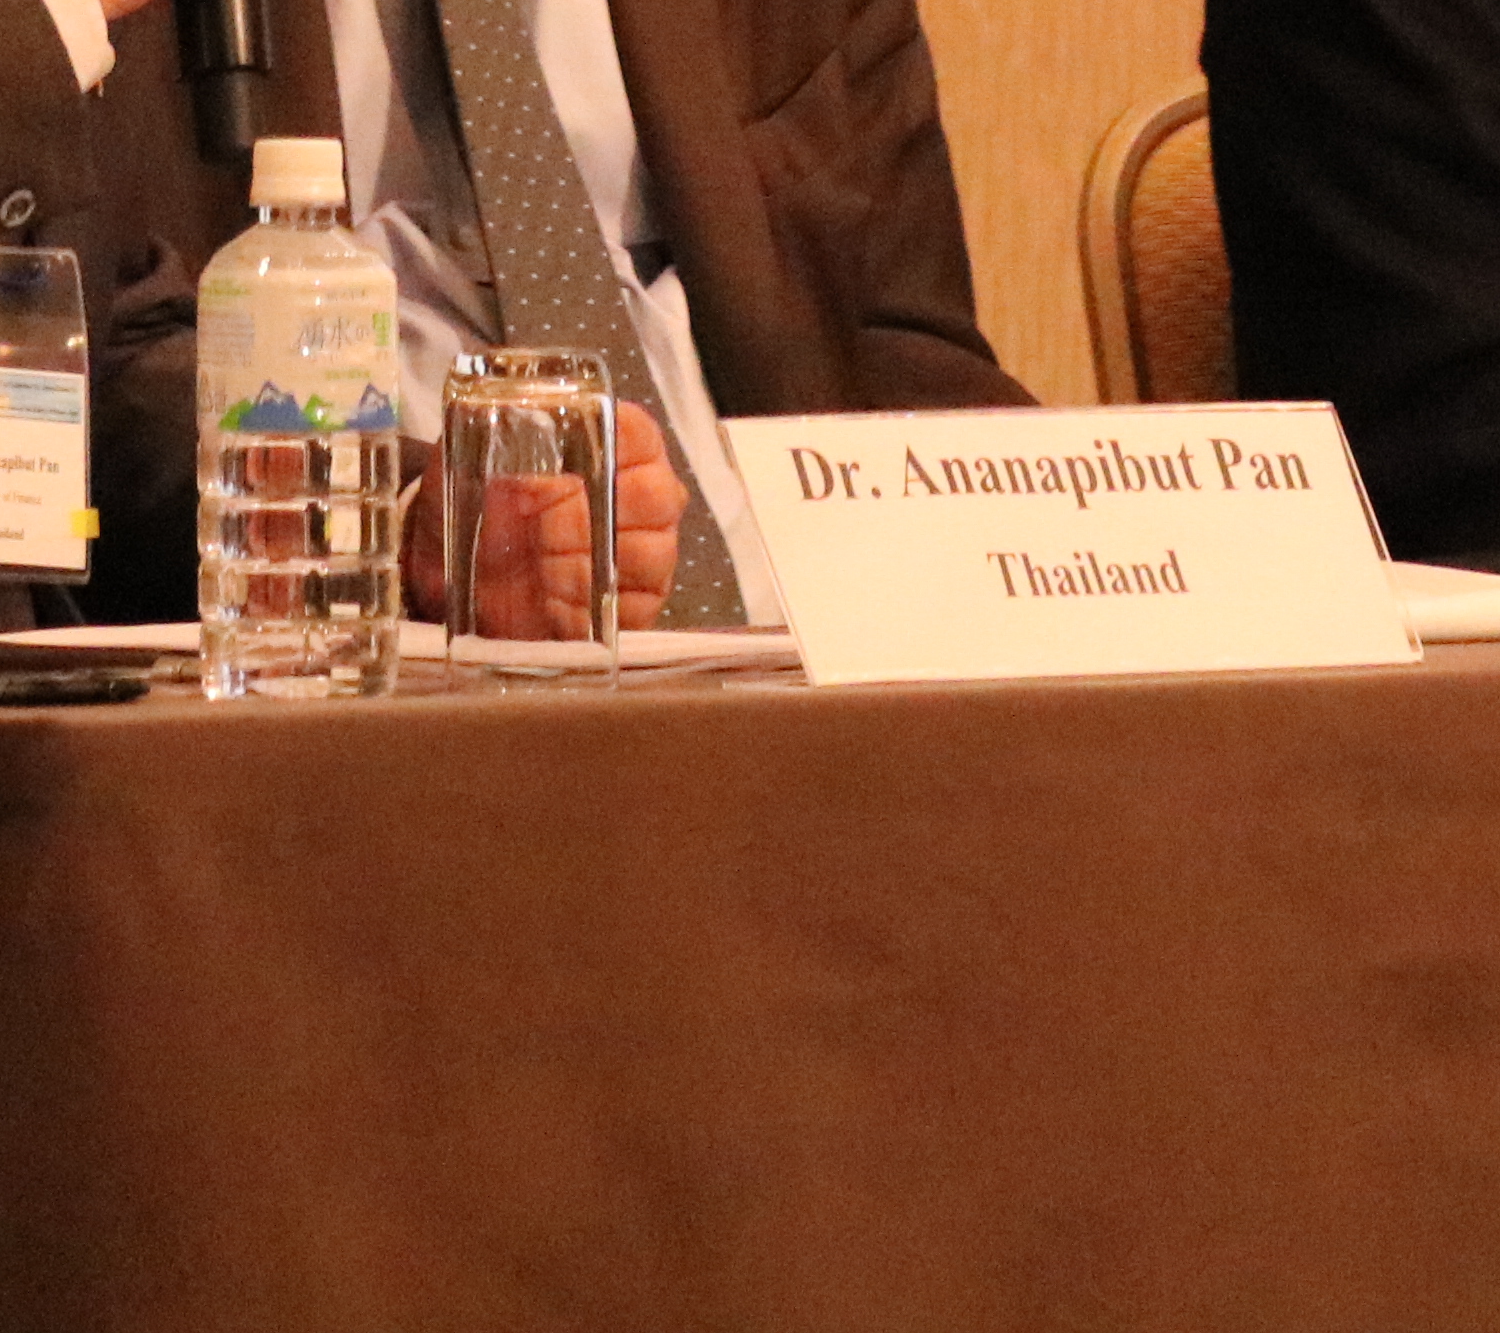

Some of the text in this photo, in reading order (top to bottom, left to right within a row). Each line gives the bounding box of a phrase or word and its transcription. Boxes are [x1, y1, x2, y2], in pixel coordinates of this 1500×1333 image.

[788, 437, 1312, 511] Dr. Ananapibut Pan
[985, 550, 1189, 599] Thailand
